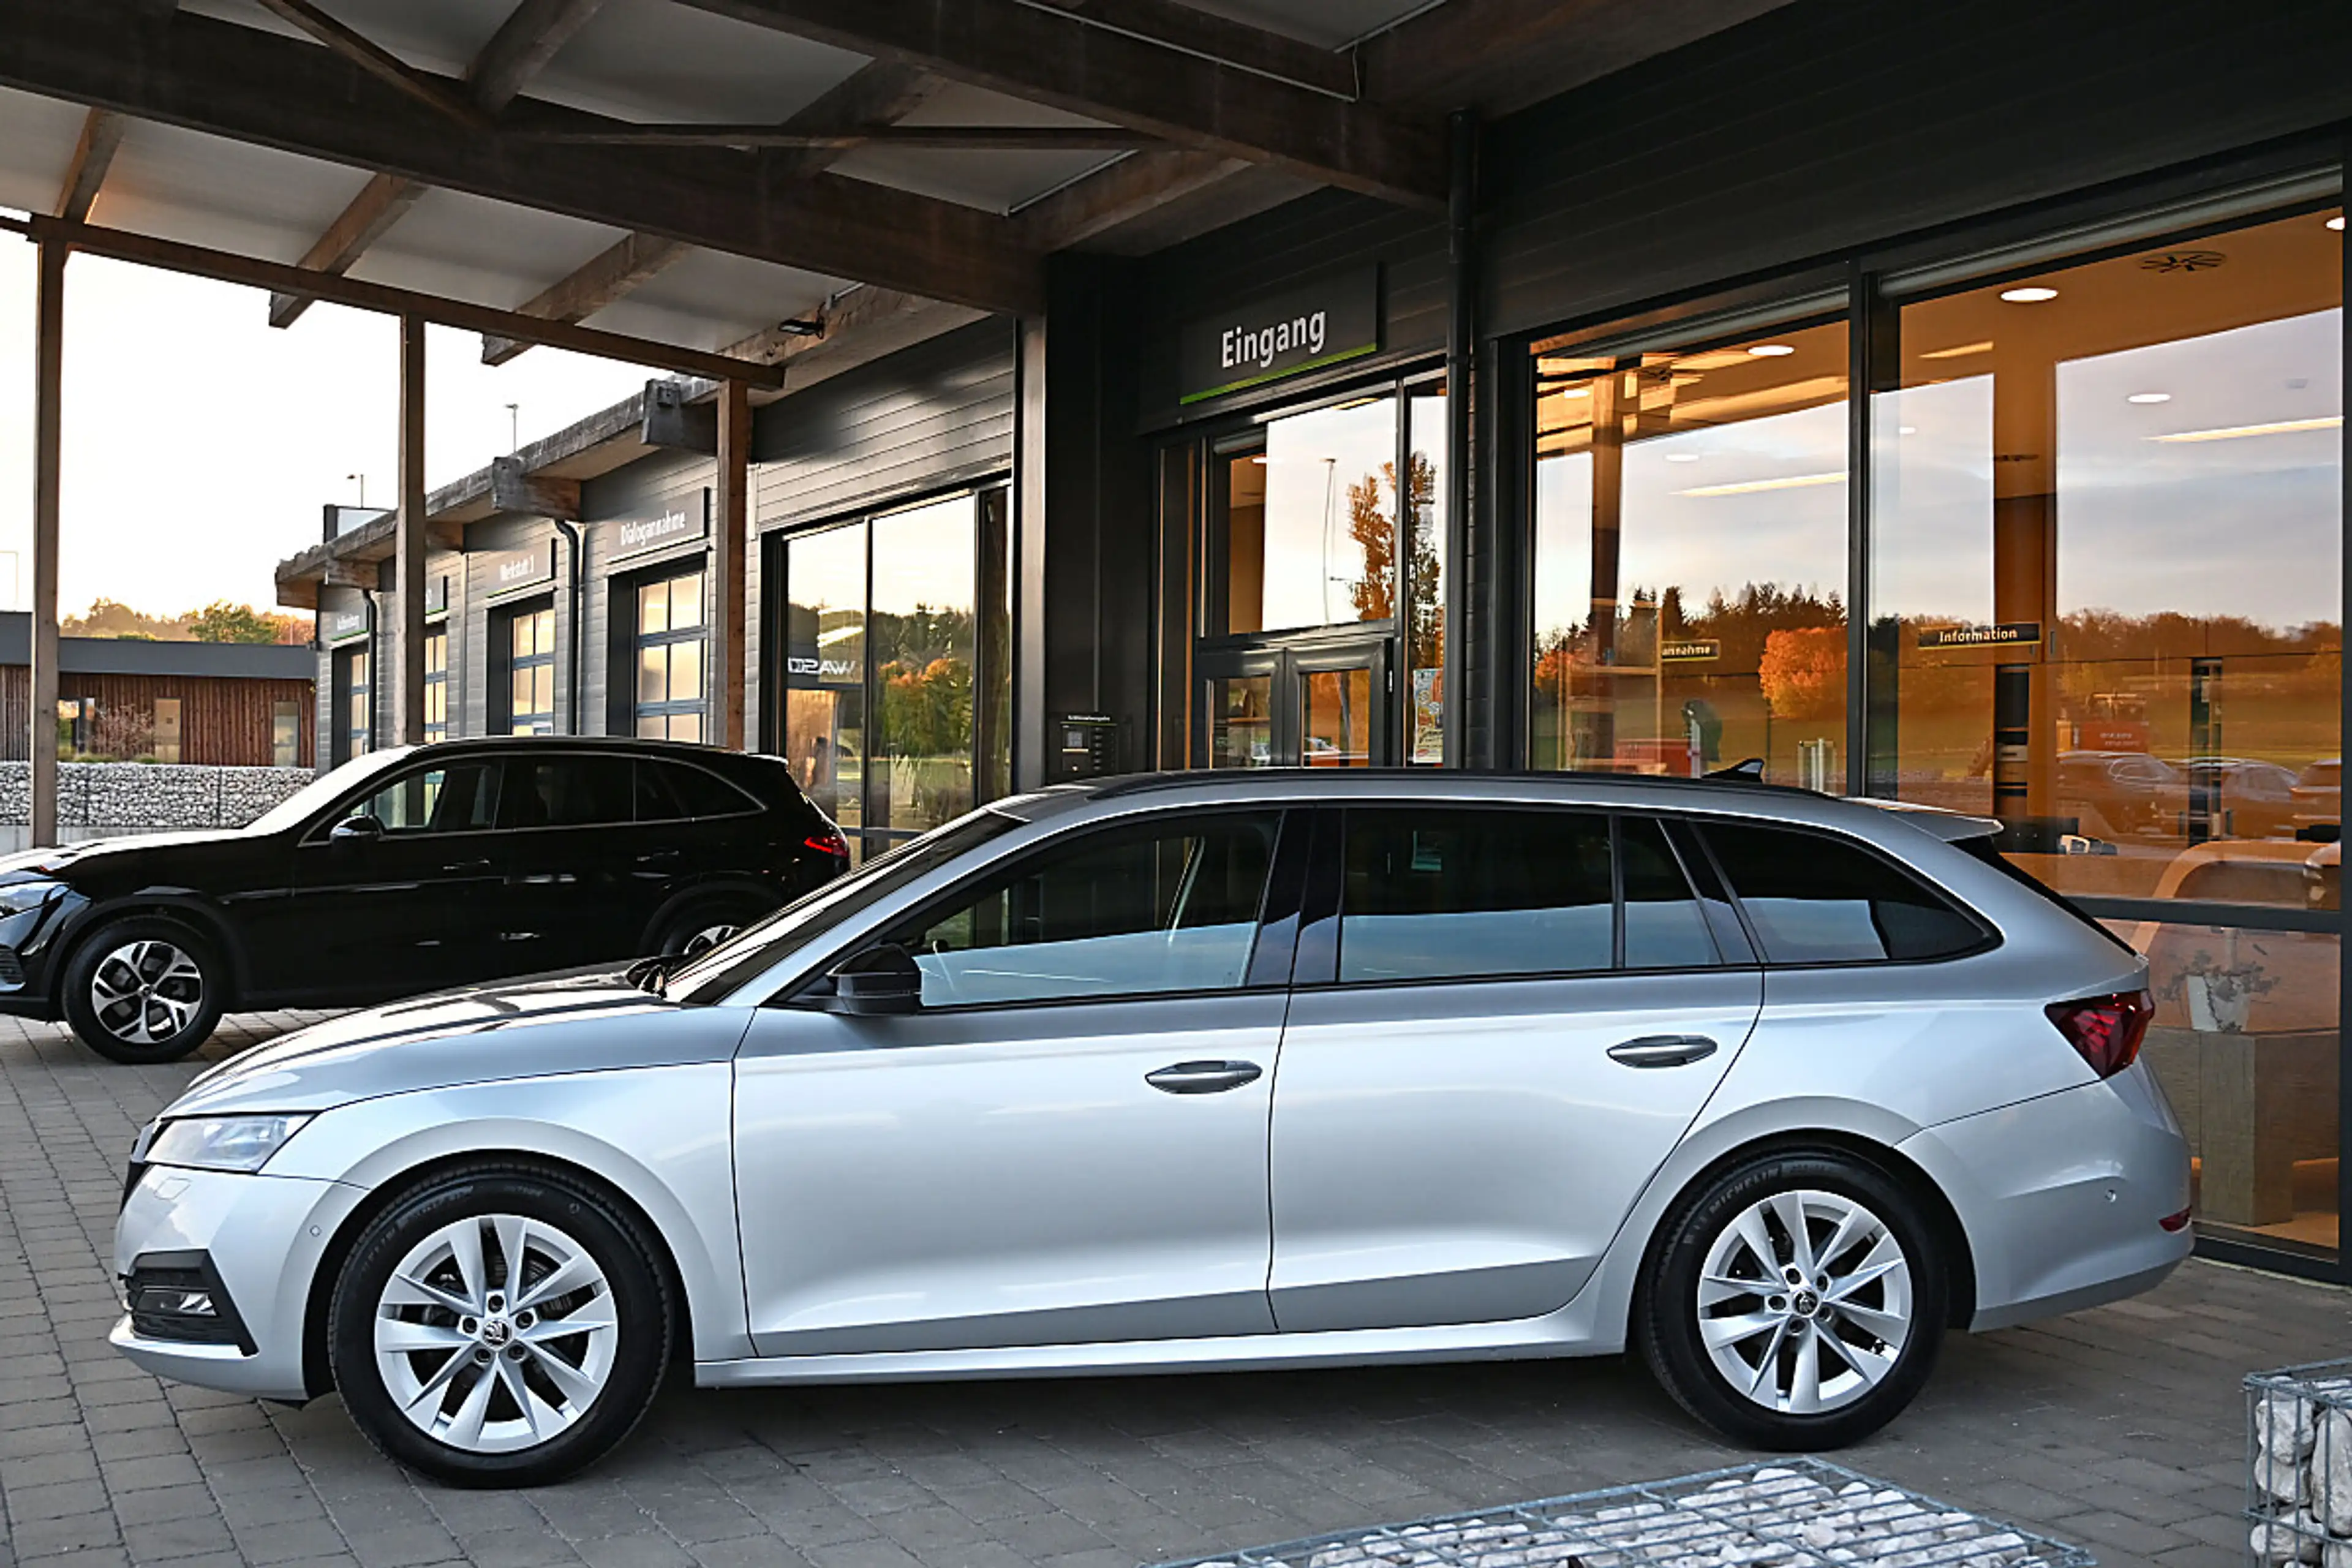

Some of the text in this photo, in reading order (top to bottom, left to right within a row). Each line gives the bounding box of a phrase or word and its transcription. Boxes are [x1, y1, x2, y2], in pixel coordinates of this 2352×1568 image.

[1223, 311, 1325, 368] Eingang
[620, 510, 685, 546] Dialogannahme
[1939, 627, 2018, 643] Information
